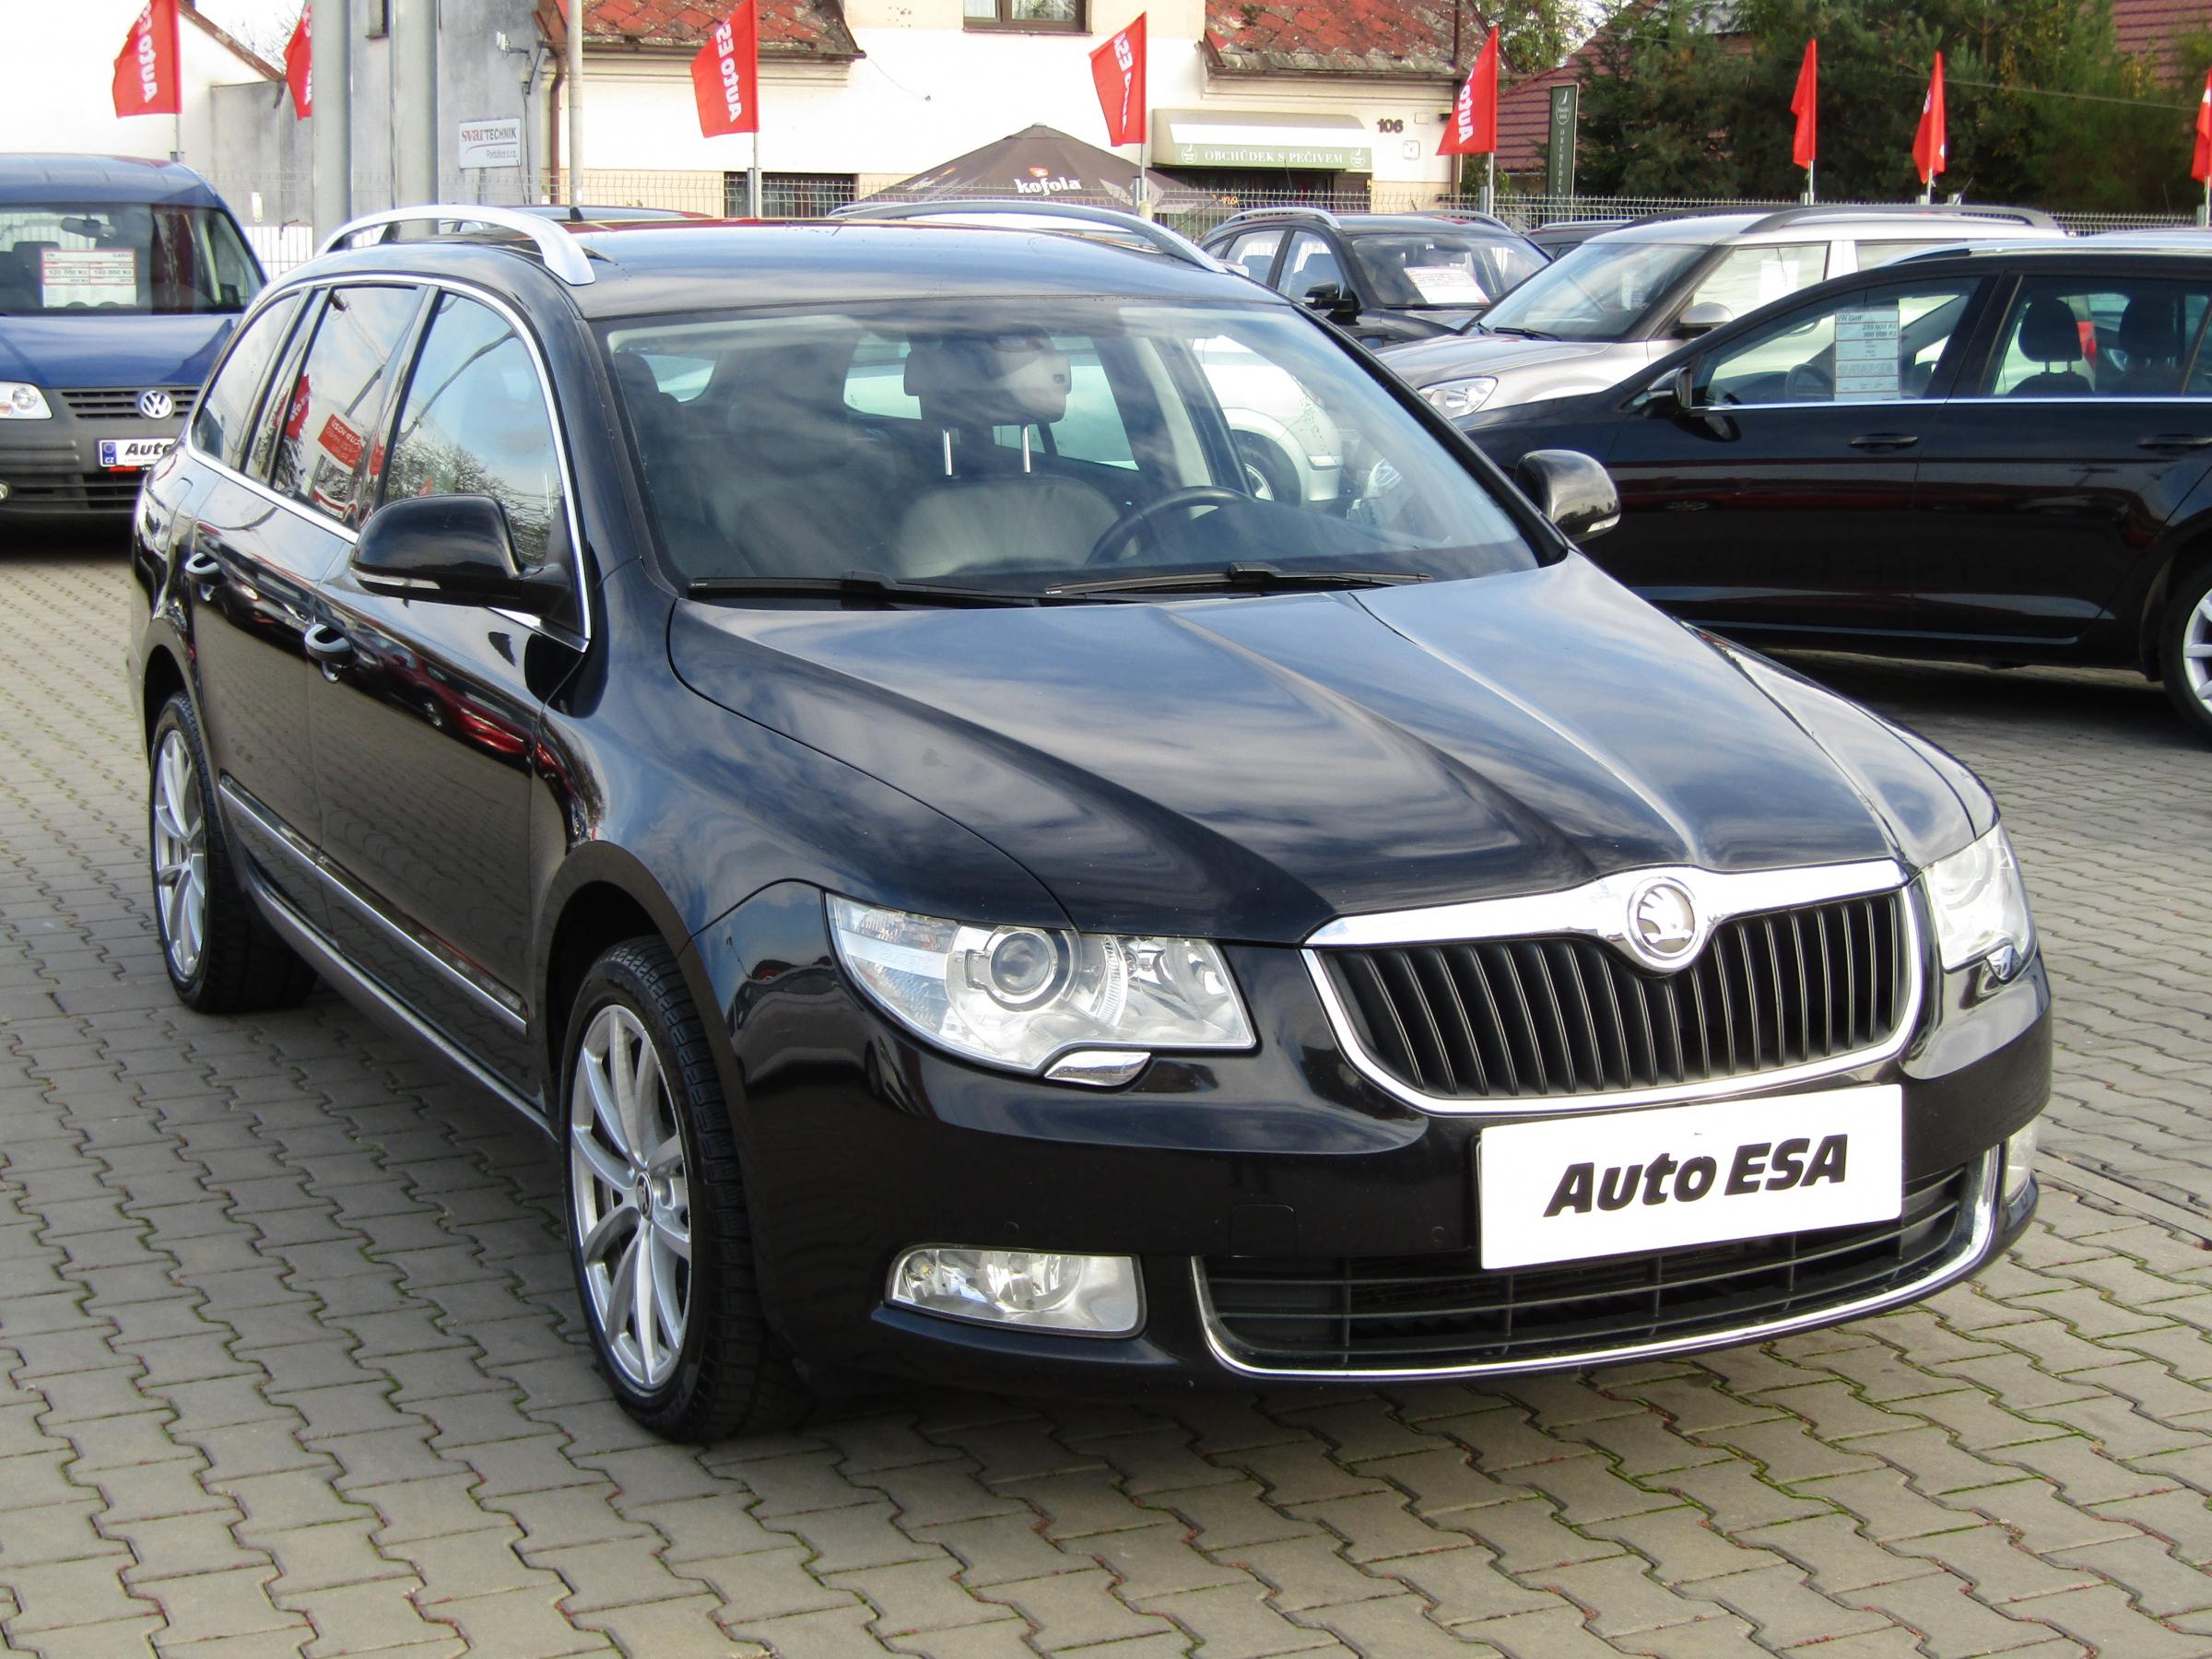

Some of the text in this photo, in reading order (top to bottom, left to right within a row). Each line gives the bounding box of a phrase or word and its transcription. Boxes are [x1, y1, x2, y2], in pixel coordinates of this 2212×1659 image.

[1376, 118, 1404, 133] 106
[1204, 149, 1274, 163] OBCHŮDEK
[1277, 152, 1286, 162] S
[1289, 151, 1344, 164] PEČIVEM
[1014, 176, 1082, 196] kofola
[1543, 1134, 1848, 1218] Auto ESA
